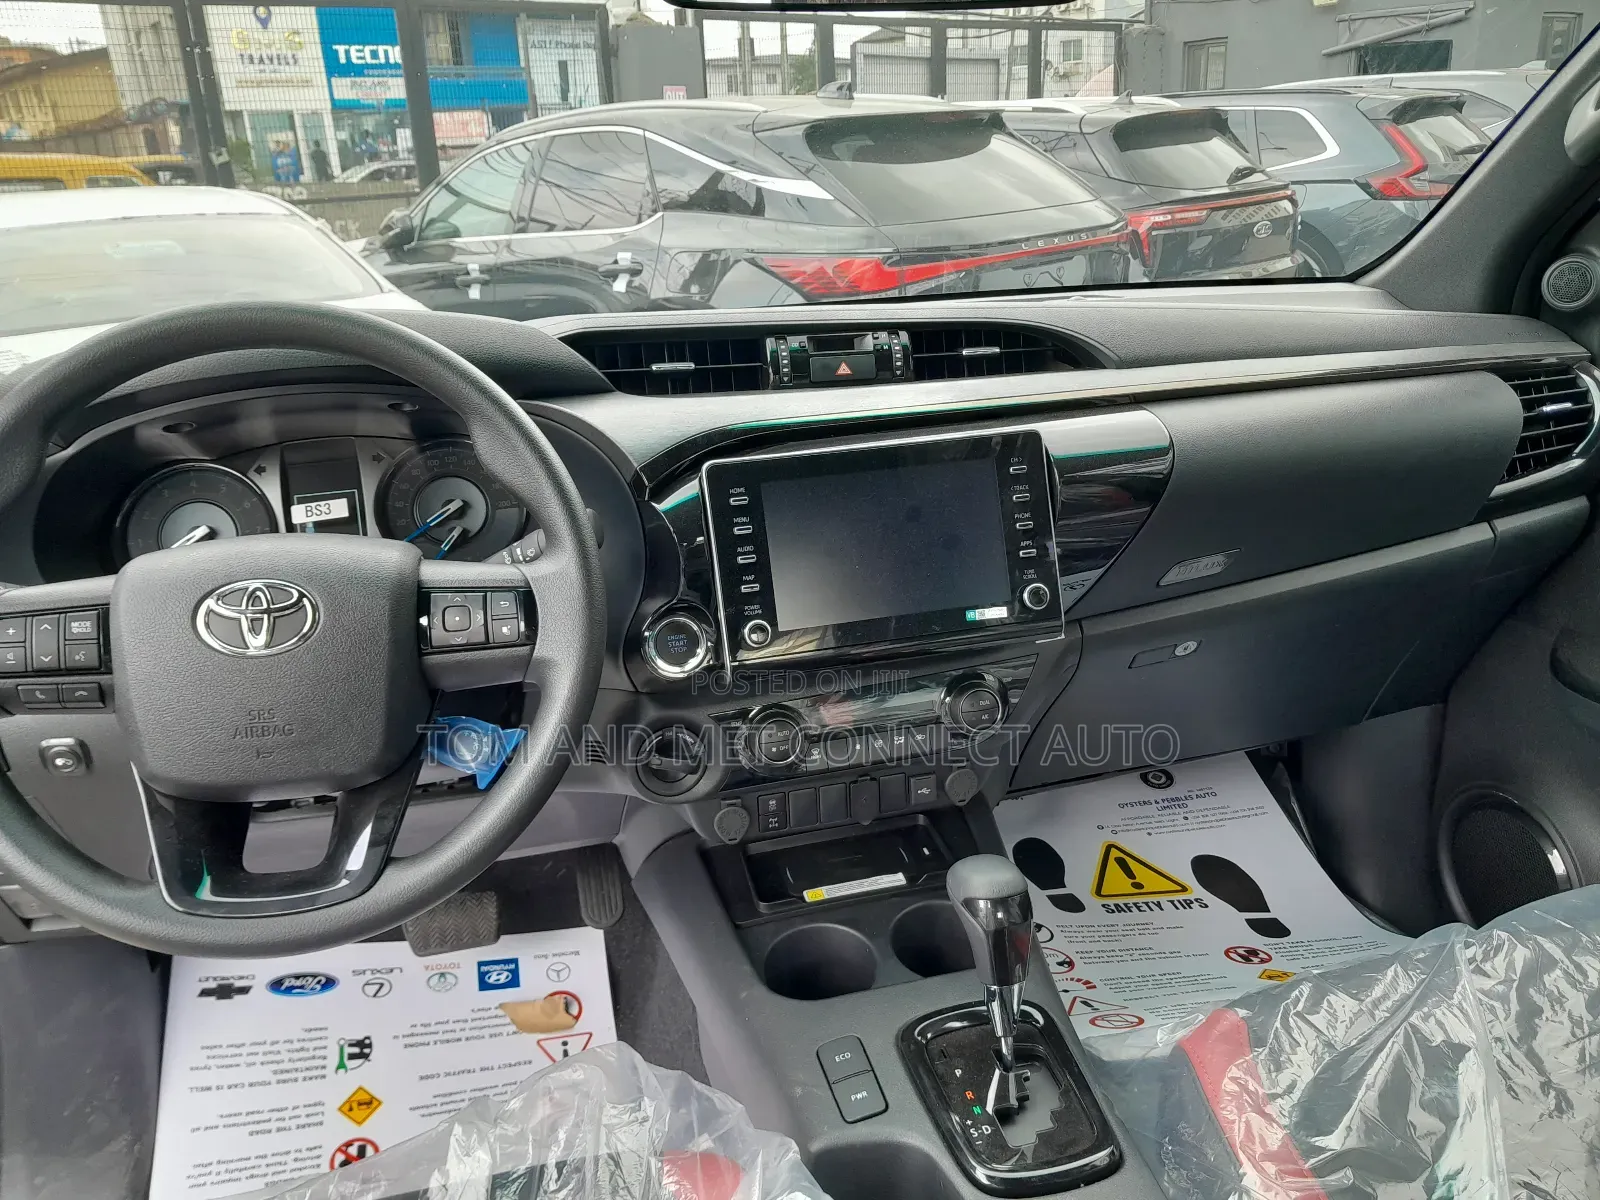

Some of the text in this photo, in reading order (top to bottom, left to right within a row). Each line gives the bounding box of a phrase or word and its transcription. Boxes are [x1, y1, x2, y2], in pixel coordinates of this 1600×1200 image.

[239, 53, 299, 66] TRAVELS
[1021, 232, 1087, 250] LEXUS
[305, 503, 332, 518] BS3
[737, 545, 754, 553] AUDIO
[668, 640, 688, 648] START
[670, 646, 688, 654] STOP
[247, 708, 277, 722] SRS
[232, 722, 296, 740] AIRBAG
[1118, 800, 1153, 809] OYSTERS
[1161, 795, 1194, 804] PEBBLES
[1195, 791, 1217, 799] AUTO
[1156, 802, 1188, 811] LIMITED
[1101, 897, 1209, 915] SAFETY TIPS
[423, 961, 462, 971] TOYOTA
[480, 963, 516, 972] HYUNDAI
[351, 966, 404, 977] LEXUS
[196, 973, 256, 983] CHEVROLET
[280, 975, 327, 994] Ford
[432, 1037, 462, 1046] MOBILE
[464, 1034, 485, 1042] YOUR
[404, 1041, 430, 1049] PHONE
[834, 1051, 851, 1062] ECO
[498, 1059, 533, 1070] RESPECT
[418, 1072, 440, 1082] CODE
[443, 1068, 476, 1077] TRAFFIC
[954, 1069, 962, 1078] P
[276, 1077, 299, 1085] SURE
[302, 1074, 327, 1082] MAKE
[226, 1082, 245, 1090] CAR
[248, 1080, 272, 1088] YOUR
[850, 1090, 868, 1102] PWR
[965, 1090, 975, 1100] R
[972, 1106, 983, 1115] N
[275, 1125, 292, 1133] THE
[295, 1120, 324, 1129] SHARE
